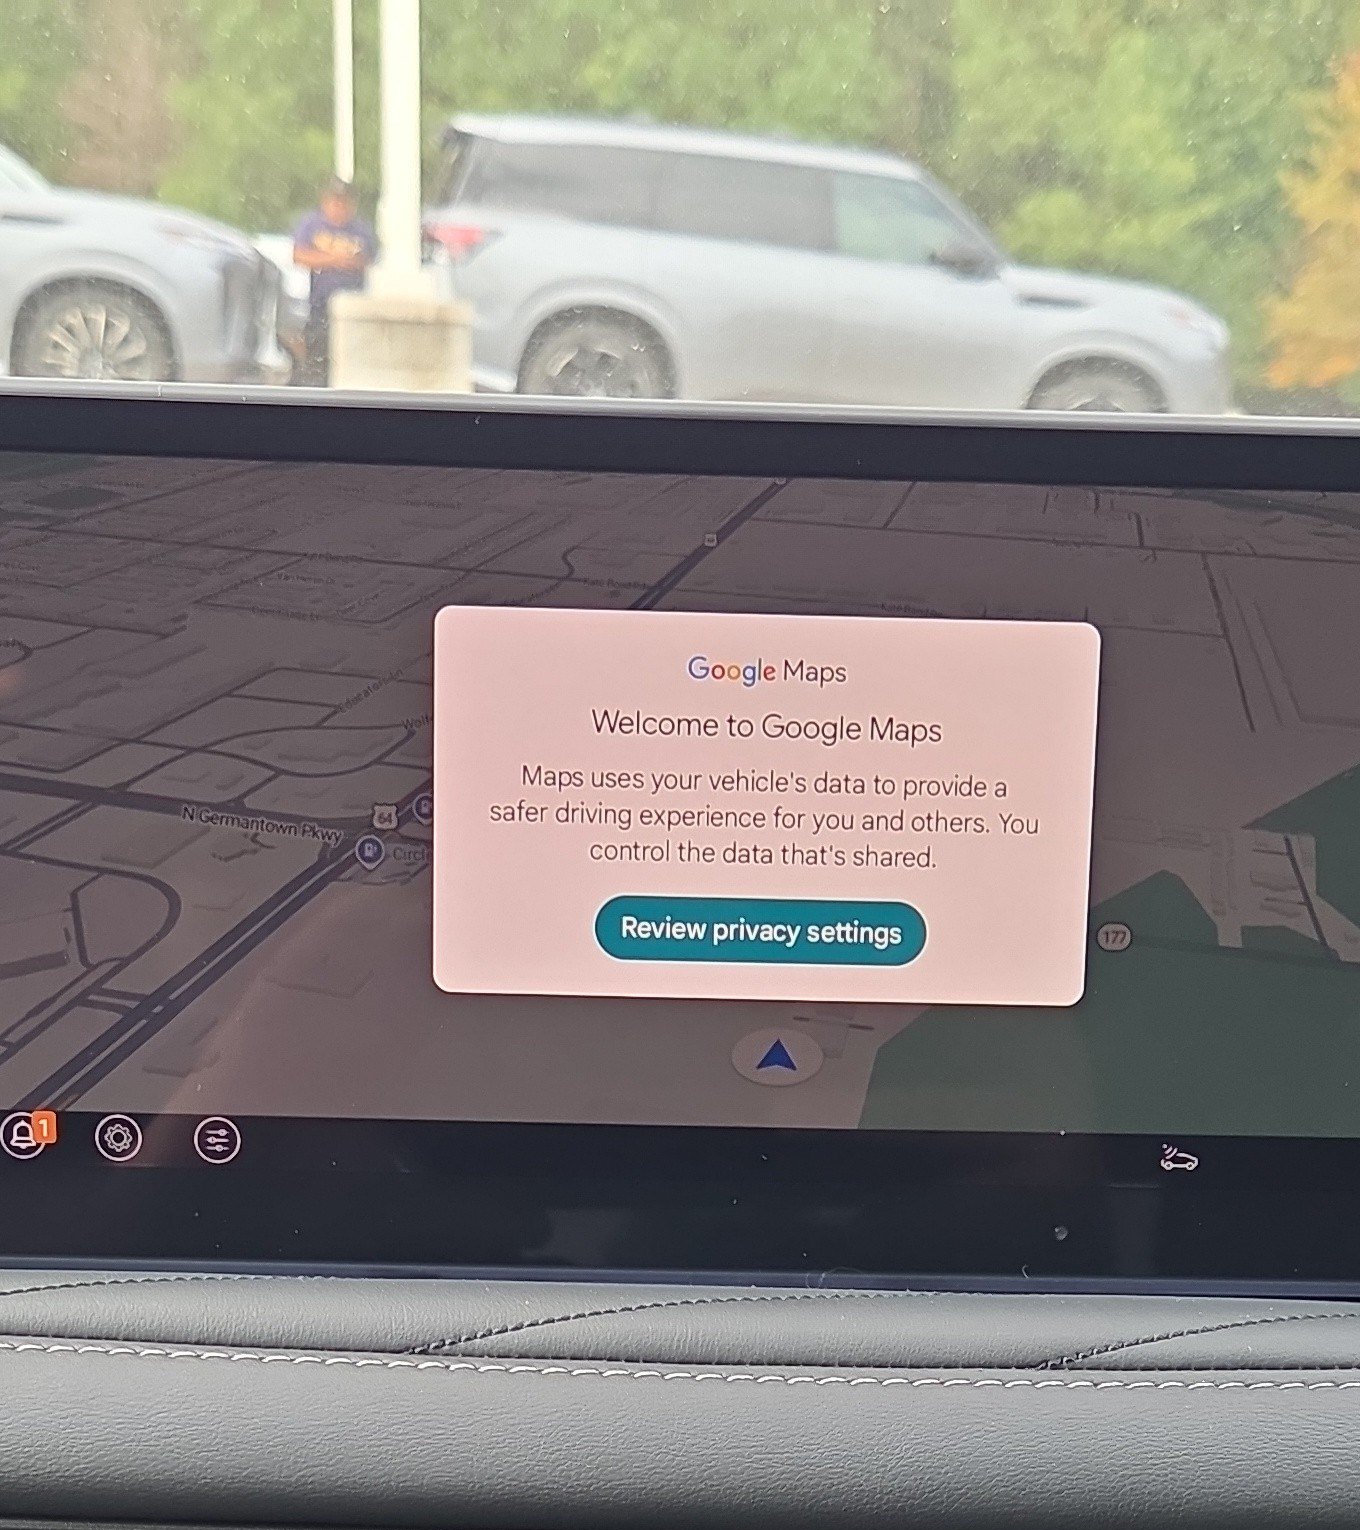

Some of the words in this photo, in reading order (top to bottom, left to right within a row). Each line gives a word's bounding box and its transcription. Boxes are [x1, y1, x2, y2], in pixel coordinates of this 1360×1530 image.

[688, 656, 777, 687] Google
[783, 659, 847, 688] Maps
[592, 708, 719, 737] Welcome
[727, 715, 754, 738] to
[762, 713, 862, 747] Google
[870, 716, 942, 748] Maps
[522, 765, 584, 792] Maps
[591, 770, 644, 789] uses
[651, 772, 702, 795] your
[709, 769, 807, 793] vehicle's
[814, 771, 865, 795] data
[873, 775, 896, 796] to
[903, 774, 987, 801] provide
[994, 781, 1007, 798] a
[182, 806, 195, 821] N
[198, 807, 297, 837] Germantown
[489, 799, 548, 823] safer
[555, 801, 632, 831] driving
[639, 804, 766, 832] experience
[774, 806, 806, 829] for
[812, 812, 854, 835] you
[861, 809, 904, 832] and
[911, 810, 990, 834] others.
[998, 812, 1038, 835] You
[589, 839, 670, 862] control
[678, 841, 716, 863] the
[722, 841, 774, 865] data
[781, 843, 846, 866] that's
[852, 844, 937, 869] shared.
[621, 915, 707, 940] Review
[713, 917, 801, 947] privacy
[807, 920, 903, 949] settings
[1104, 930, 1127, 945] 177
